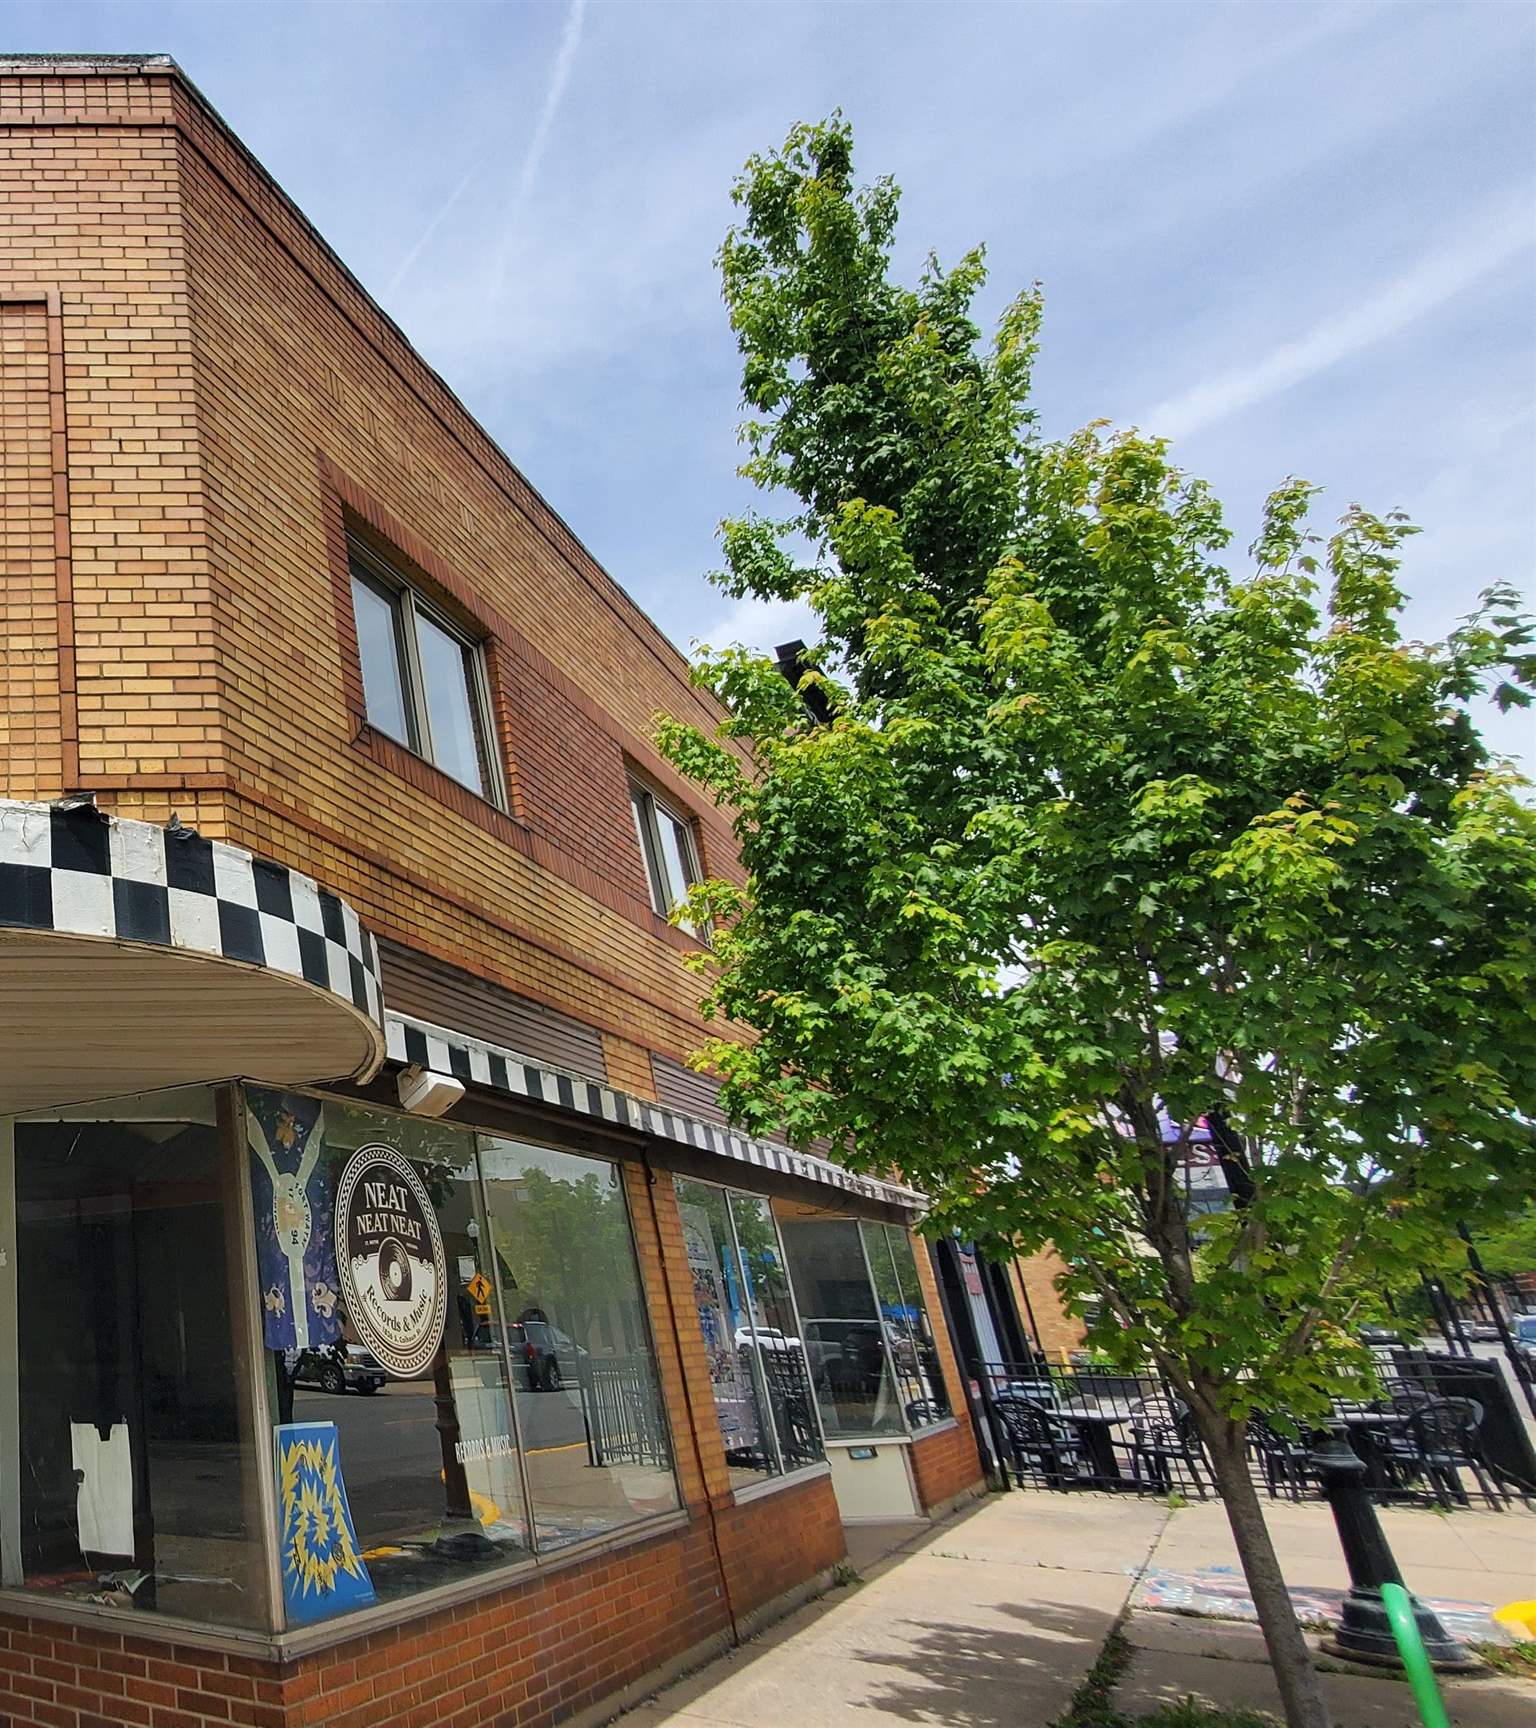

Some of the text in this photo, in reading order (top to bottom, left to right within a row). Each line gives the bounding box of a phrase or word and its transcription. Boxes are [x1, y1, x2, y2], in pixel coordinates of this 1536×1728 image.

[364, 1182, 408, 1212] NEAT
[290, 1229, 299, 1246] 94
[356, 1213, 422, 1240] NEAT NEAT
[366, 1284, 428, 1332] Records & Music
[454, 1438, 485, 1464] RECORDS
[491, 1433, 512, 1457] MUSIC
